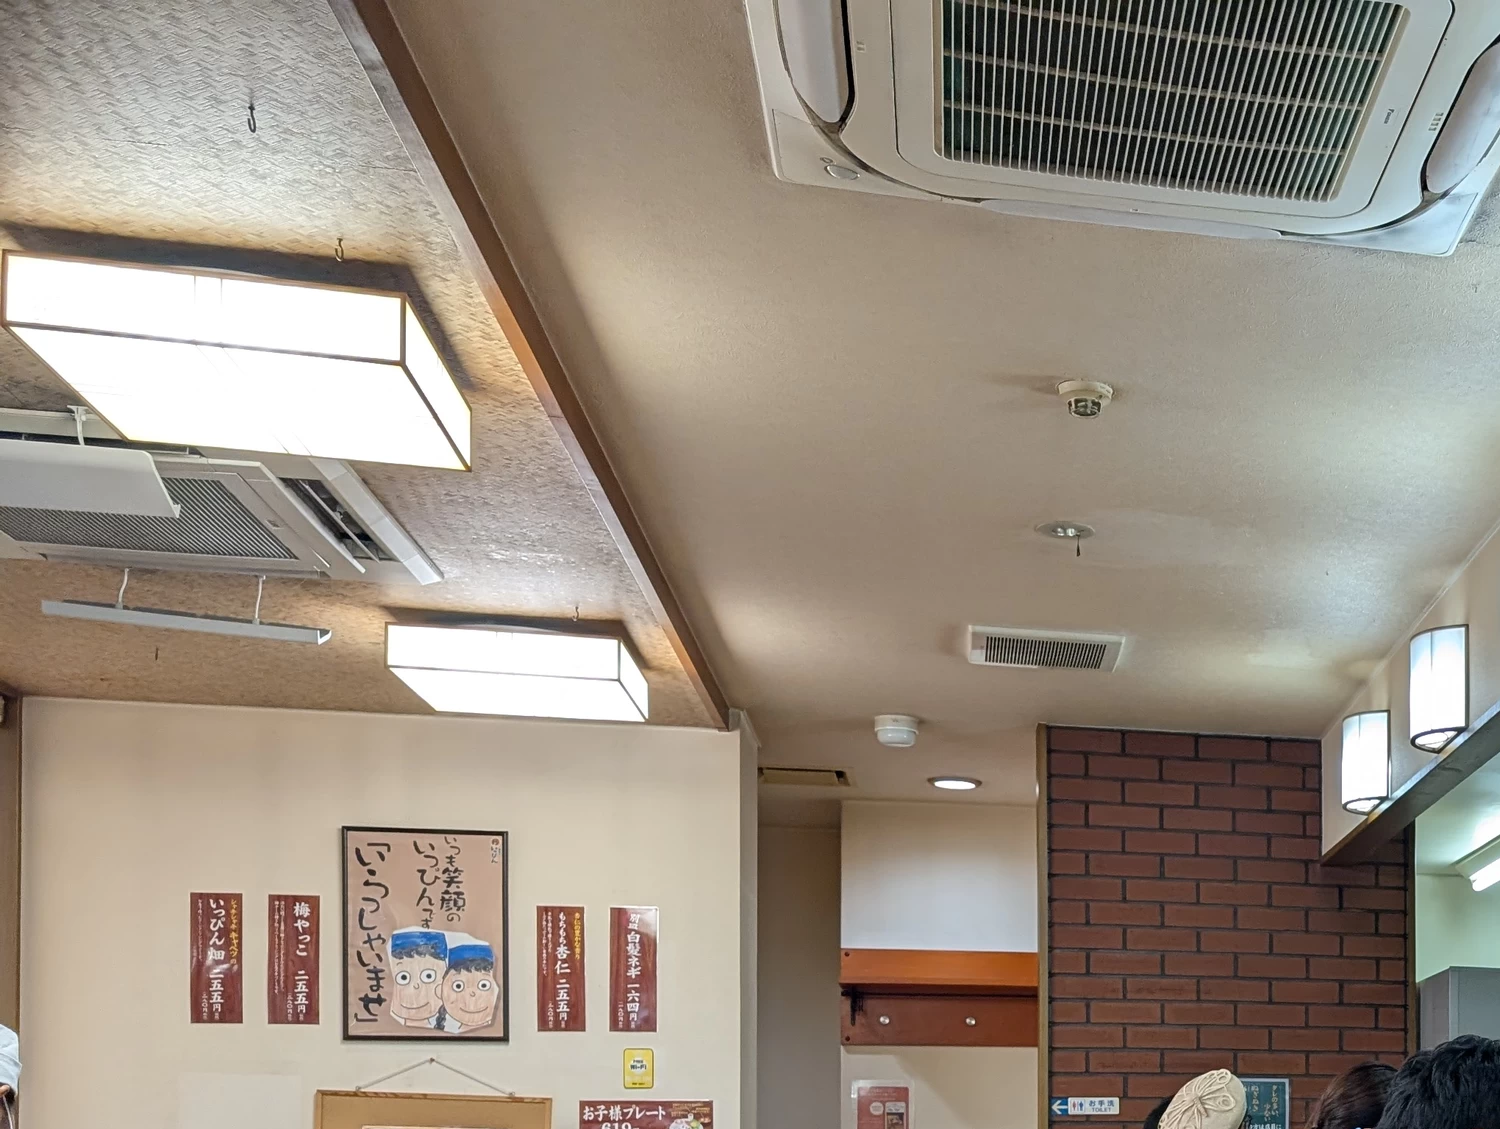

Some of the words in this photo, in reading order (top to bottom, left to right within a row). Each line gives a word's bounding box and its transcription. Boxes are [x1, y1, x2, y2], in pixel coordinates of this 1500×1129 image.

[413, 840, 440, 929] いっぴんです
[440, 836, 467, 922] いつも笑顔の
[294, 902, 311, 956] 梅やっこ
[583, 1105, 666, 1121] お子様プレート
